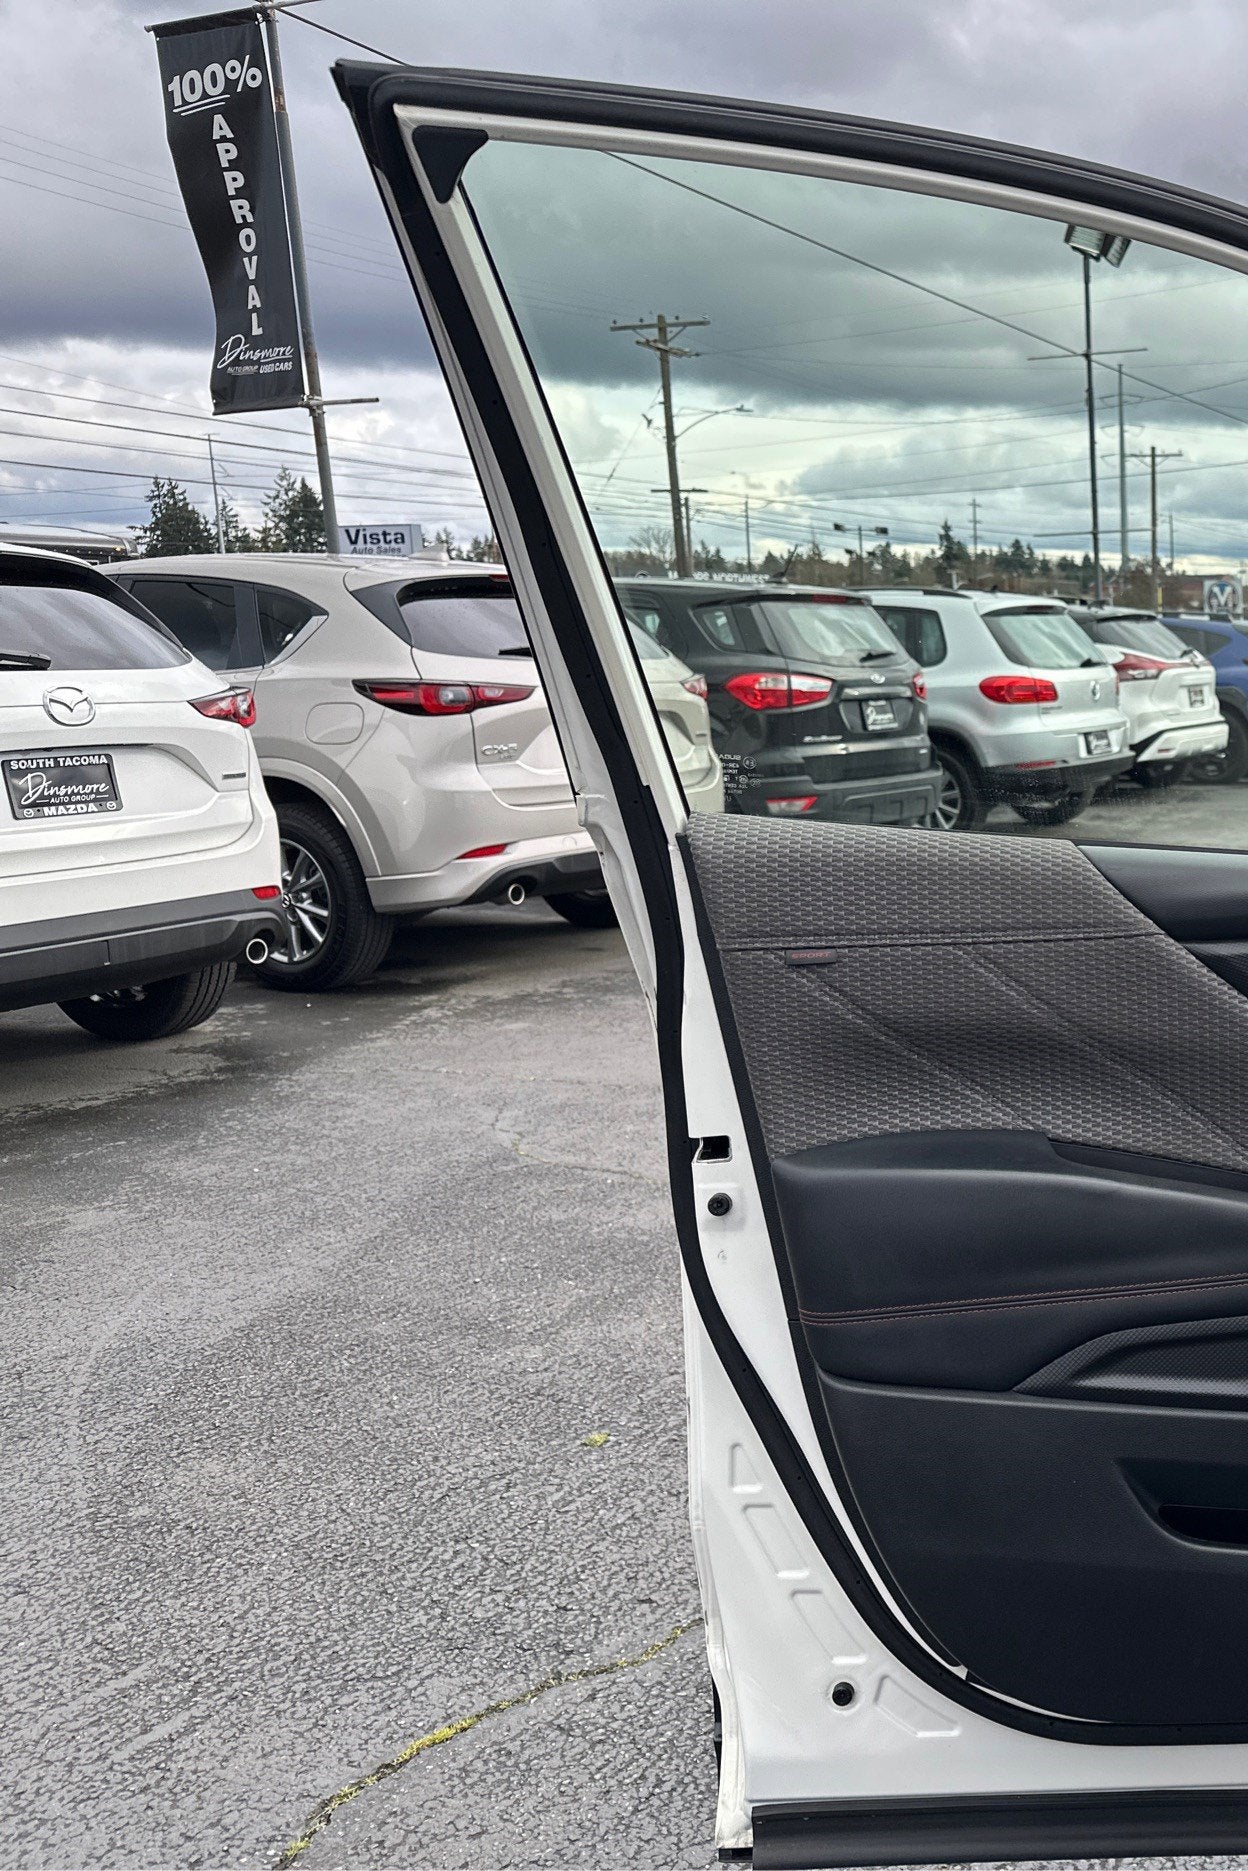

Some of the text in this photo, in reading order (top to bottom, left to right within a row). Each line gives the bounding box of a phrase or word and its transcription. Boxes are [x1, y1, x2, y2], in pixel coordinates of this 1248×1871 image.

[168, 55, 262, 107] 100%
[212, 114, 263, 336] APPROVAL
[217, 334, 294, 369] Dinsmore
[260, 363, 274, 373] USED
[275, 361, 293, 371] CARS
[345, 528, 405, 545] Vista
[351, 546, 402, 555] Auto Sales
[10, 755, 108, 770] SOUTH TACOMA
[19, 772, 110, 805] Dinsmore
[71, 794, 96, 802] GROUP
[43, 803, 99, 816] MAZDA
